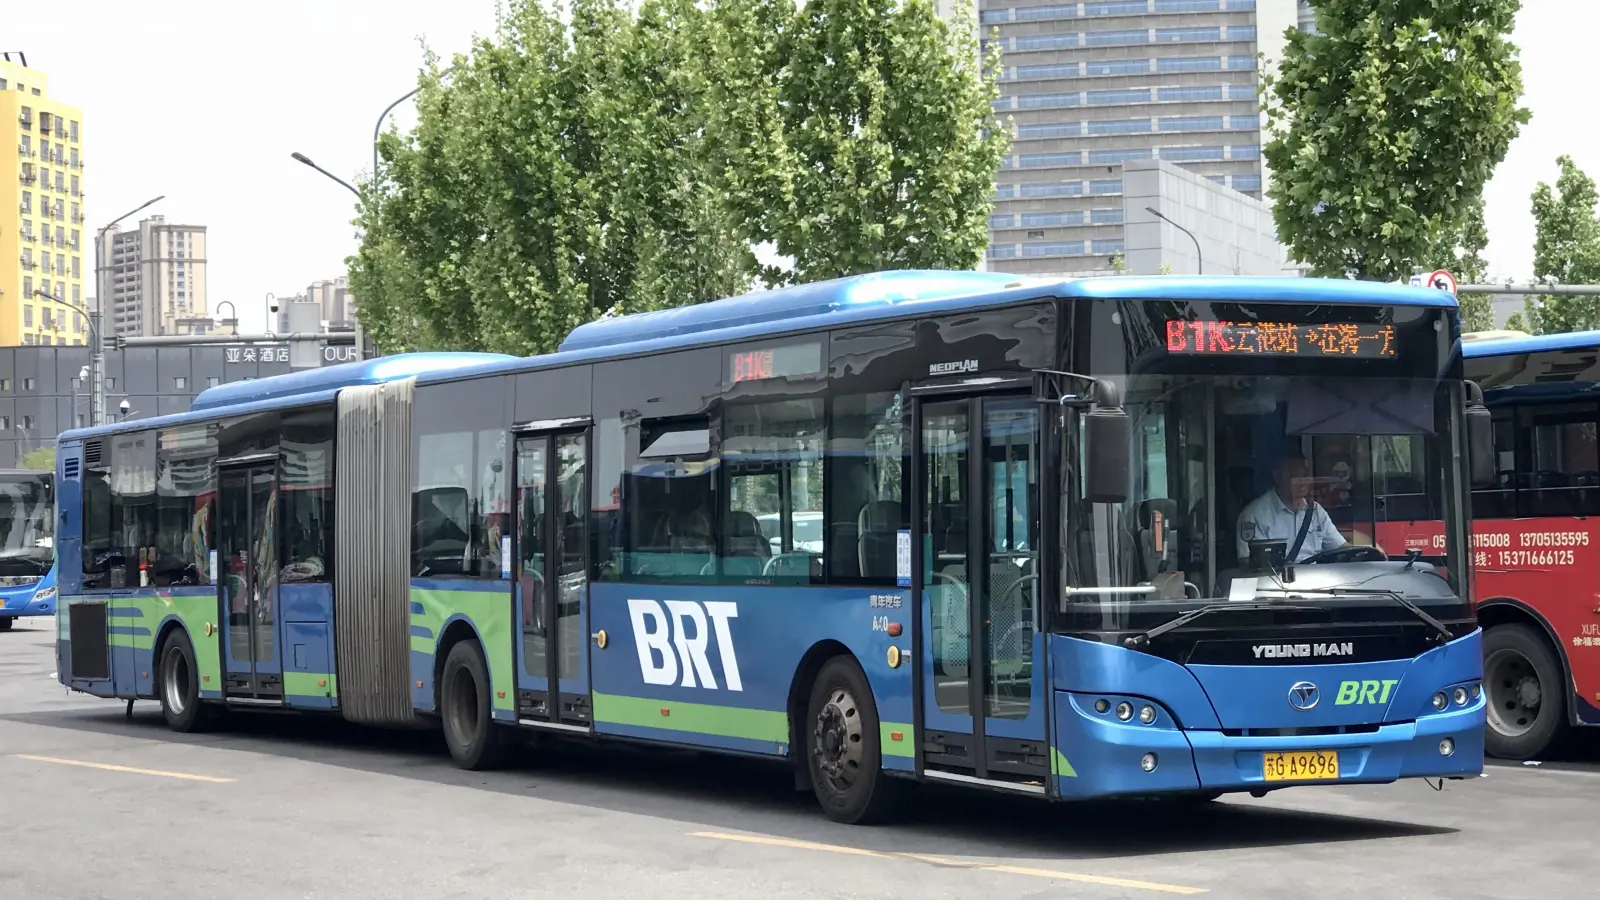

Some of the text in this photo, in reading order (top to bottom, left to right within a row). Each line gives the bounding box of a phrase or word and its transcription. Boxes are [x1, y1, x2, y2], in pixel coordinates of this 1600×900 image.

[1166, 320, 1230, 352] B1K
[226, 346, 357, 362] 亚朵酒店 OUR
[929, 359, 979, 376] NEOPLAN
[1519, 531, 1589, 547] 13705135595
[1498, 550, 1574, 566] 15371666125
[869, 594, 902, 609] 青年汽车
[626, 598, 743, 692] BRT
[1252, 642, 1354, 658] YOUNG MAN
[1334, 679, 1398, 706] BRT
